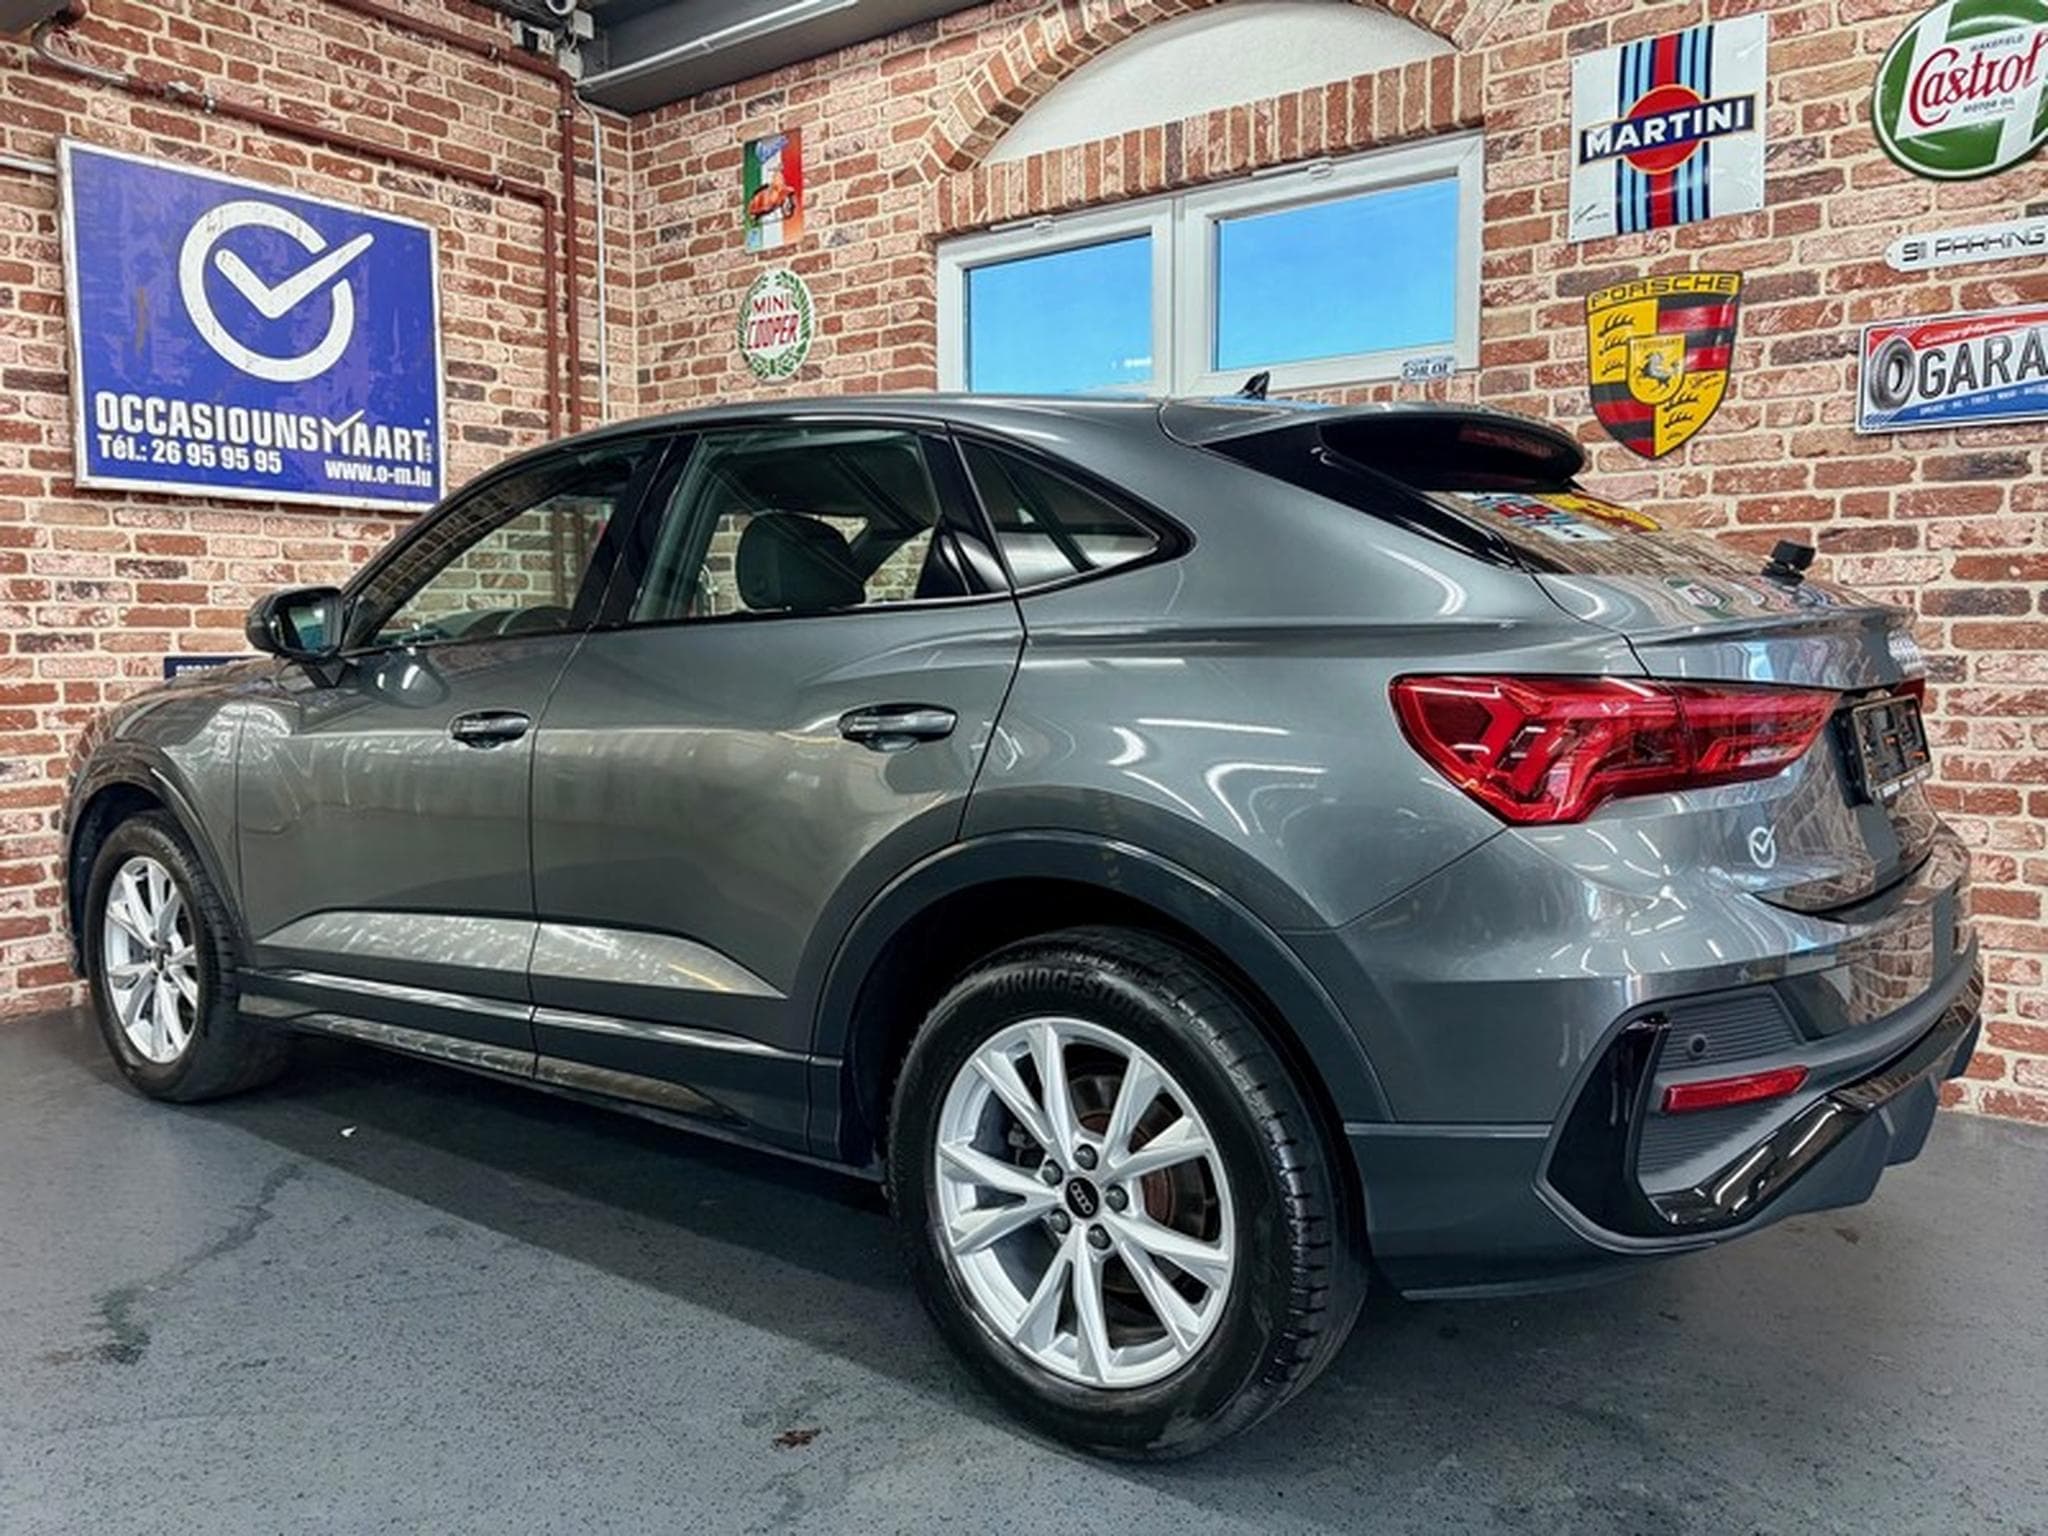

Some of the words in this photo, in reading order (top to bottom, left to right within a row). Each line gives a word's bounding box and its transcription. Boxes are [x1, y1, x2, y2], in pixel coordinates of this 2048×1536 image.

[1909, 29, 2048, 128] Castrol
[1586, 99, 1747, 158] MARTINI
[752, 292, 790, 316] MINI
[1591, 275, 1733, 308] PORSCHE
[747, 313, 799, 350] COOPER
[97, 433, 147, 462] Tél.:
[151, 439, 181, 465] 26
[186, 442, 216, 468] 95
[221, 445, 250, 471] 95
[253, 449, 283, 475] 95
[324, 459, 432, 488] www.o-m.lu
